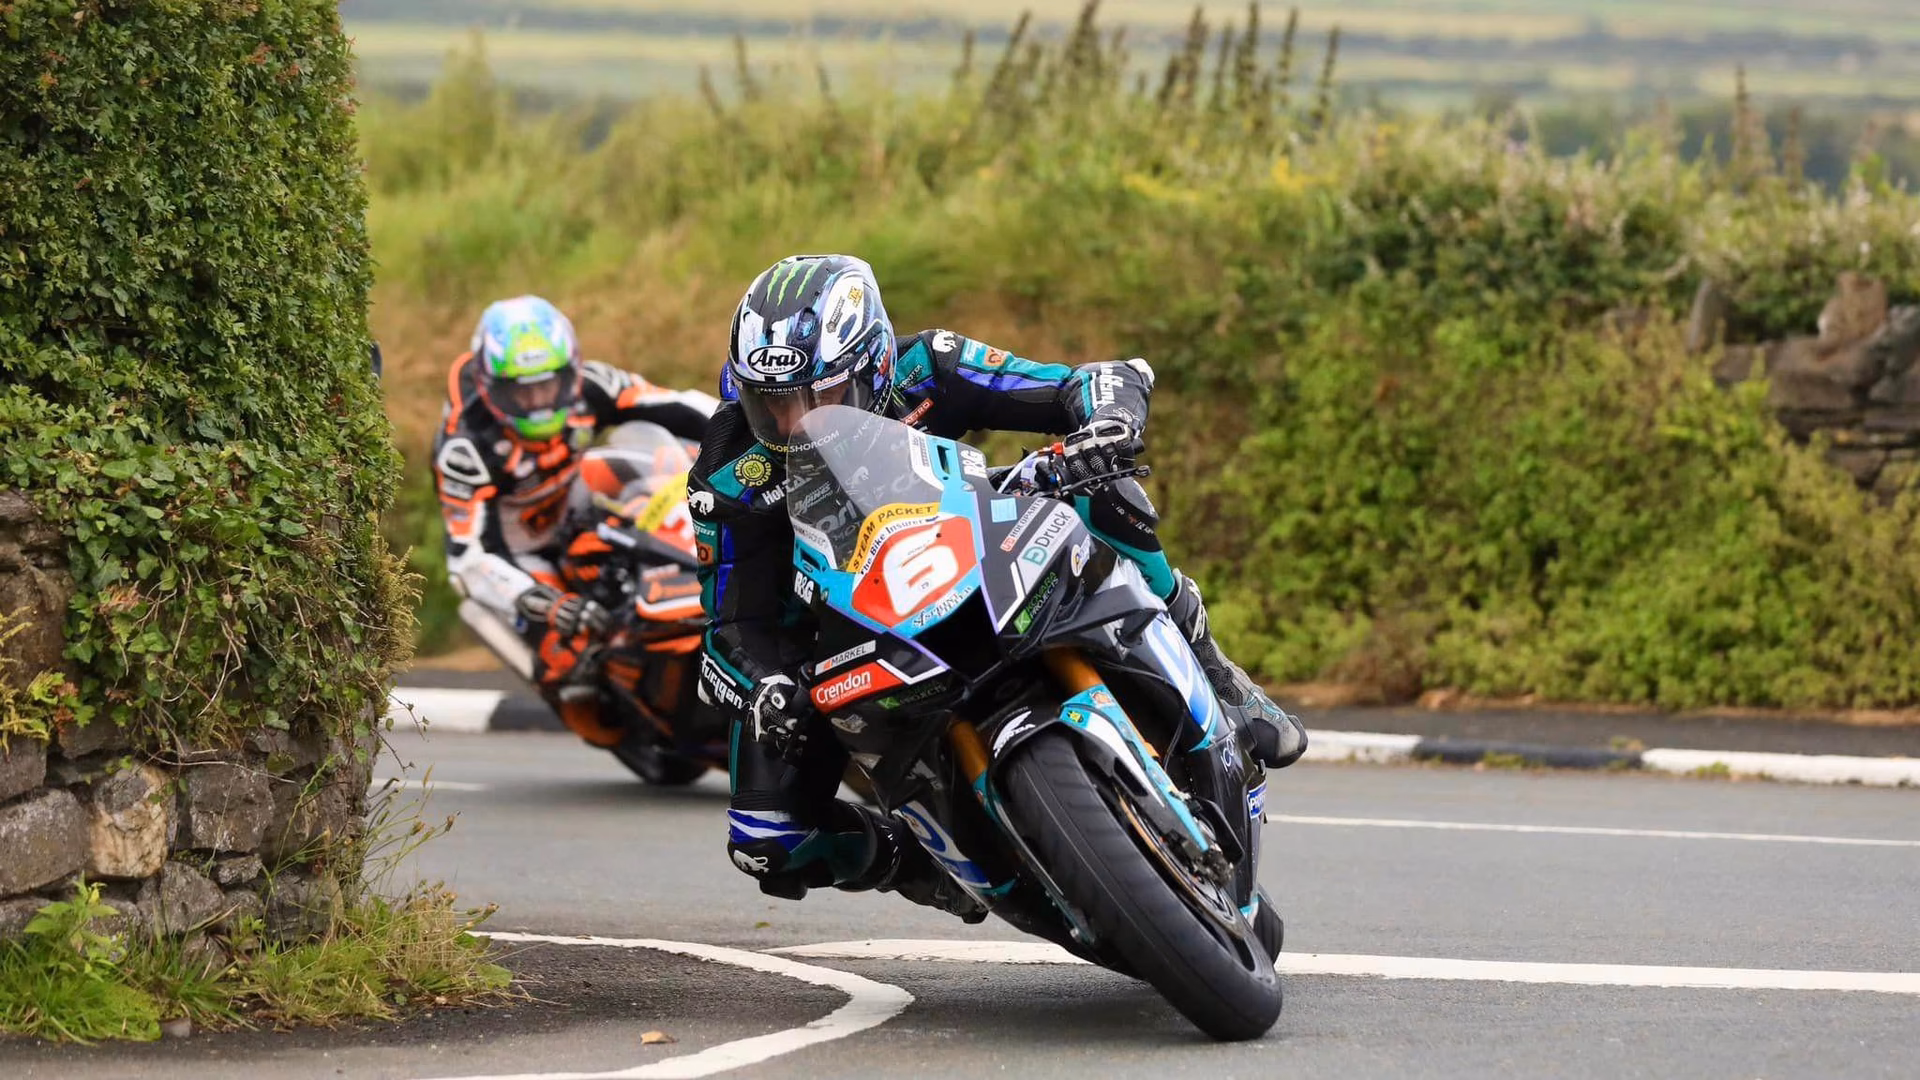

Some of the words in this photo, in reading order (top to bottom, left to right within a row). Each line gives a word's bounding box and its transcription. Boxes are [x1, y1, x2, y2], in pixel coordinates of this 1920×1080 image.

[750, 349, 798, 367] Arai
[735, 453, 767, 477] AROUND
[961, 450, 987, 478] R&G
[853, 521, 876, 570] STEAM
[877, 505, 933, 523] PACKET
[870, 533, 886, 556] Bike
[885, 519, 924, 534] Insurer
[1034, 511, 1071, 547] Druck
[883, 524, 960, 617] 6
[794, 571, 814, 605] R&G
[1030, 578, 1058, 618] PROJECTS
[830, 645, 867, 666] MARKEL
[816, 670, 871, 704] Crendon
